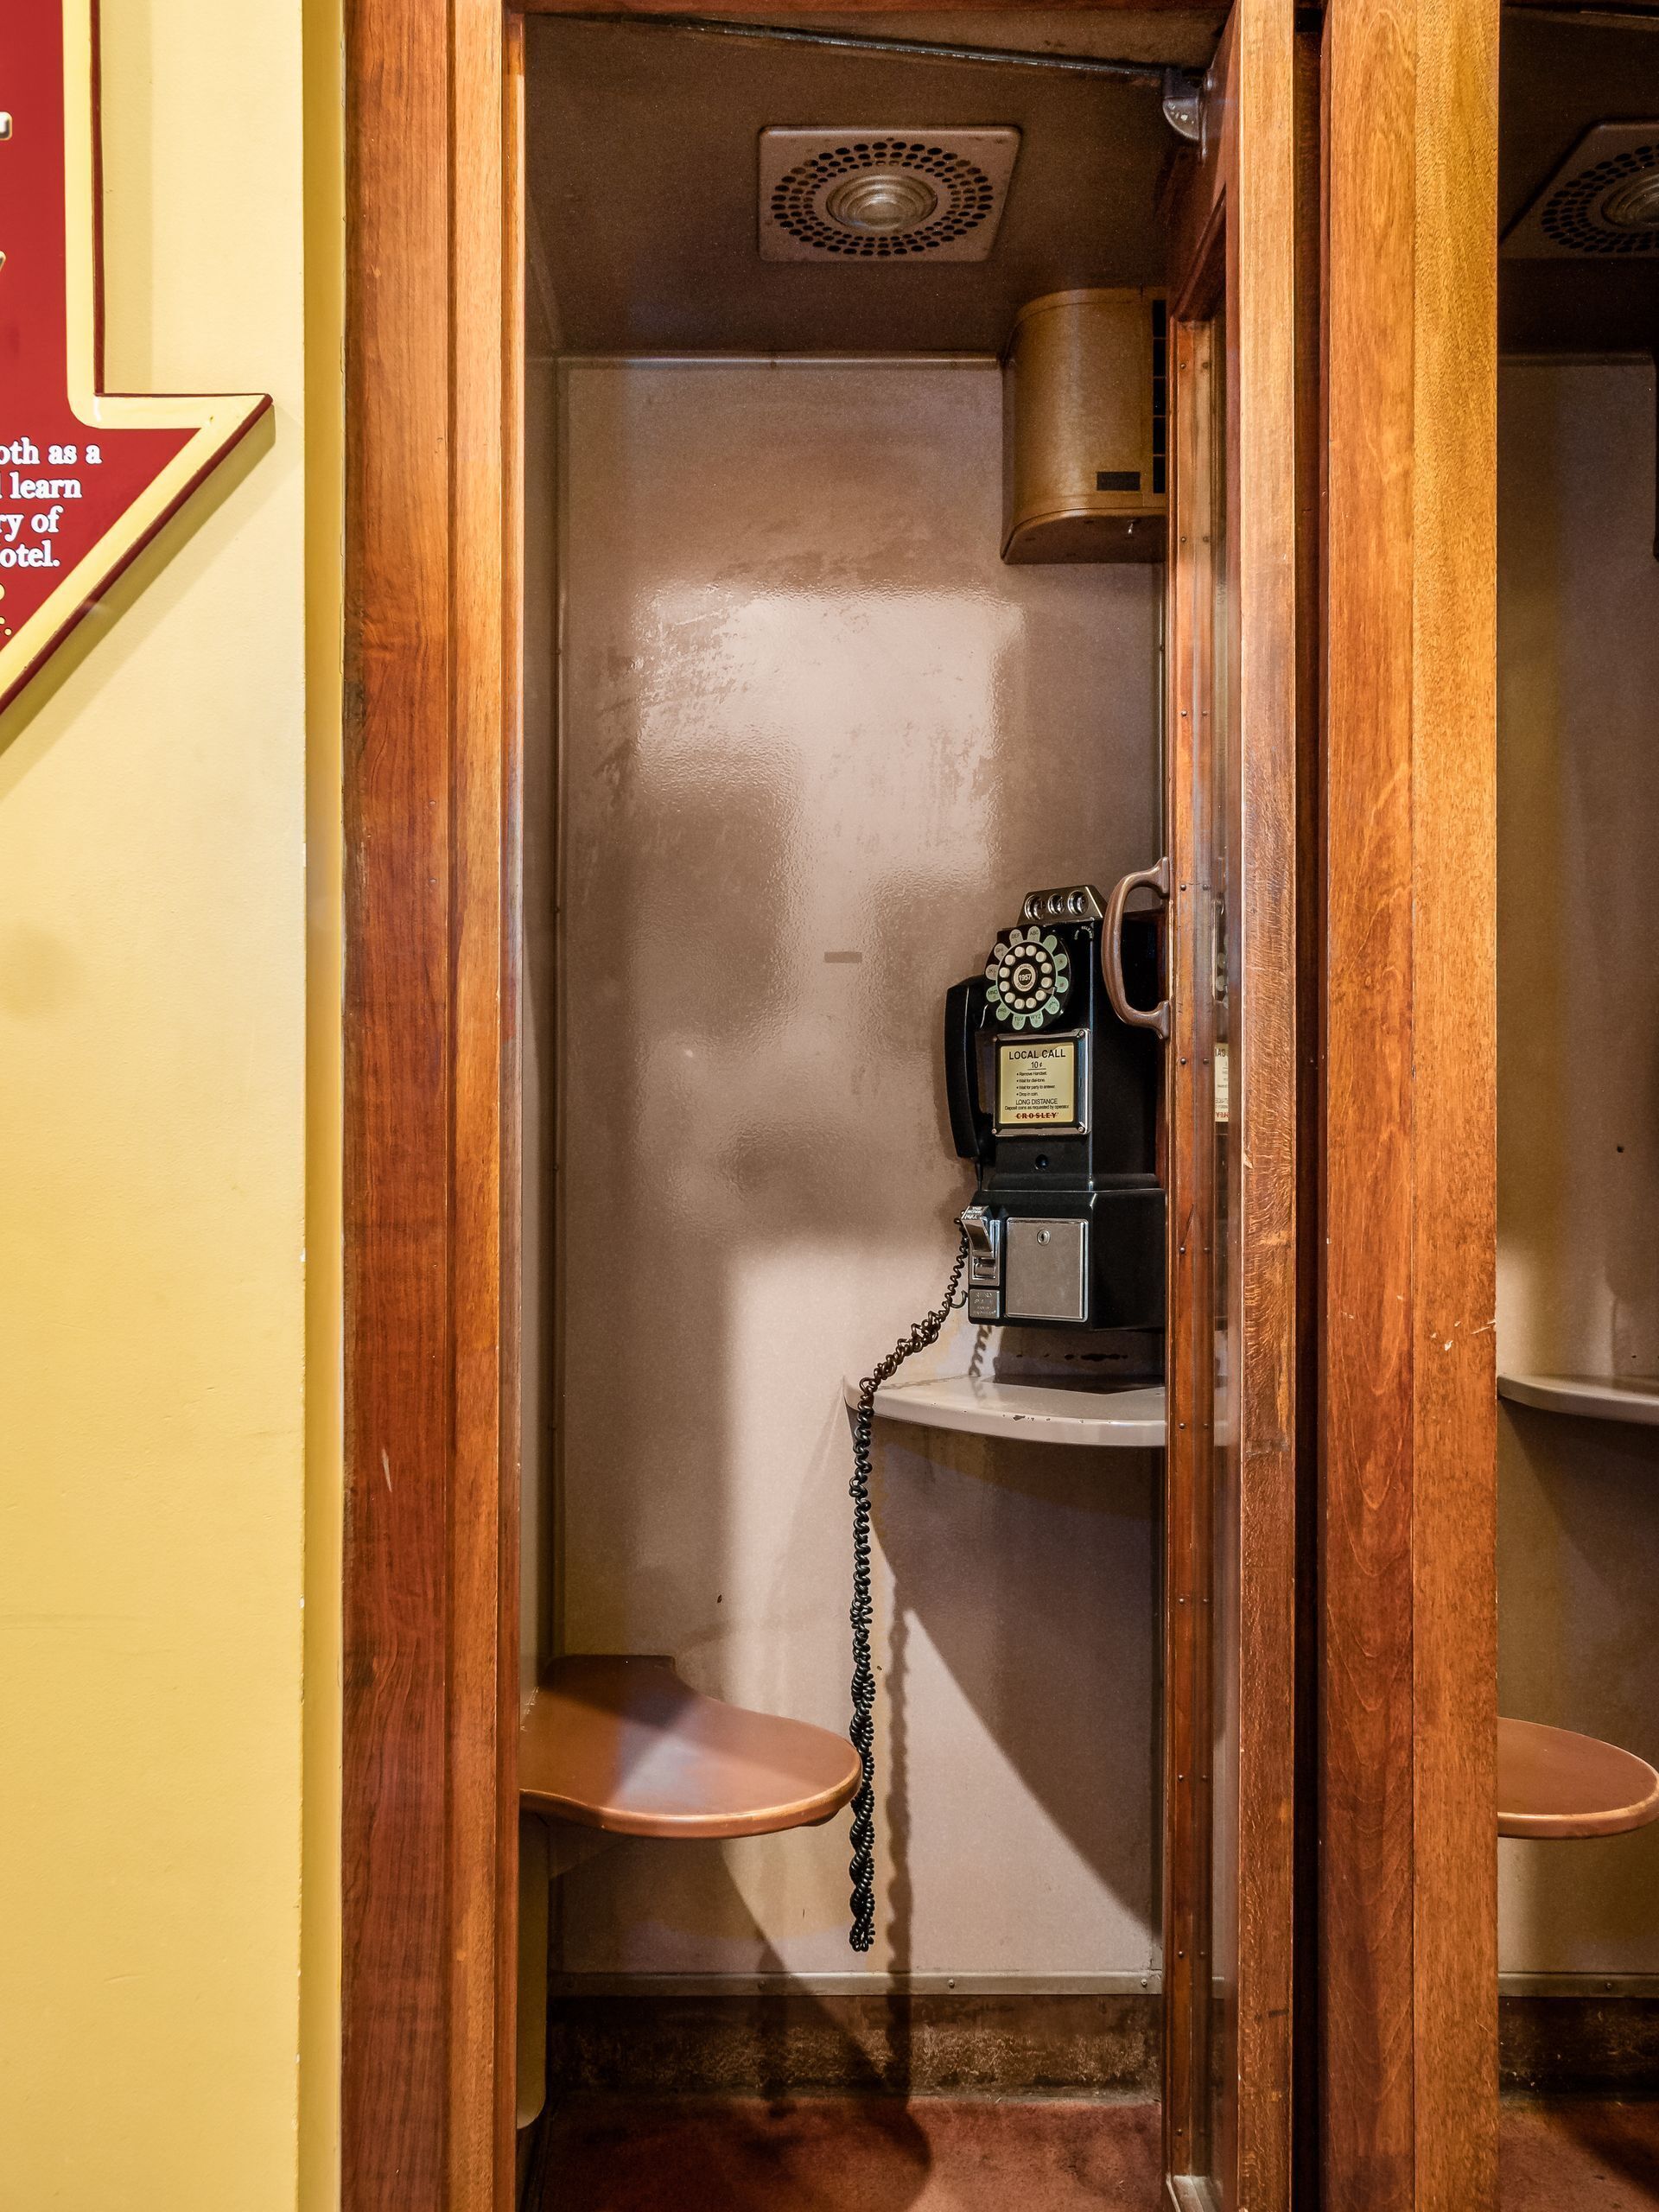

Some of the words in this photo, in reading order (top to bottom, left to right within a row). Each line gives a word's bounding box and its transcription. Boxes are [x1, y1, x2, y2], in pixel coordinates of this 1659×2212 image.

[48, 444, 77, 464] as
[86, 444, 102, 464] a
[10, 471, 82, 499] learn
[31, 505, 64, 533] of
[1009, 1051, 1039, 1060] LOCAL
[1041, 1049, 1066, 1058] CALL
